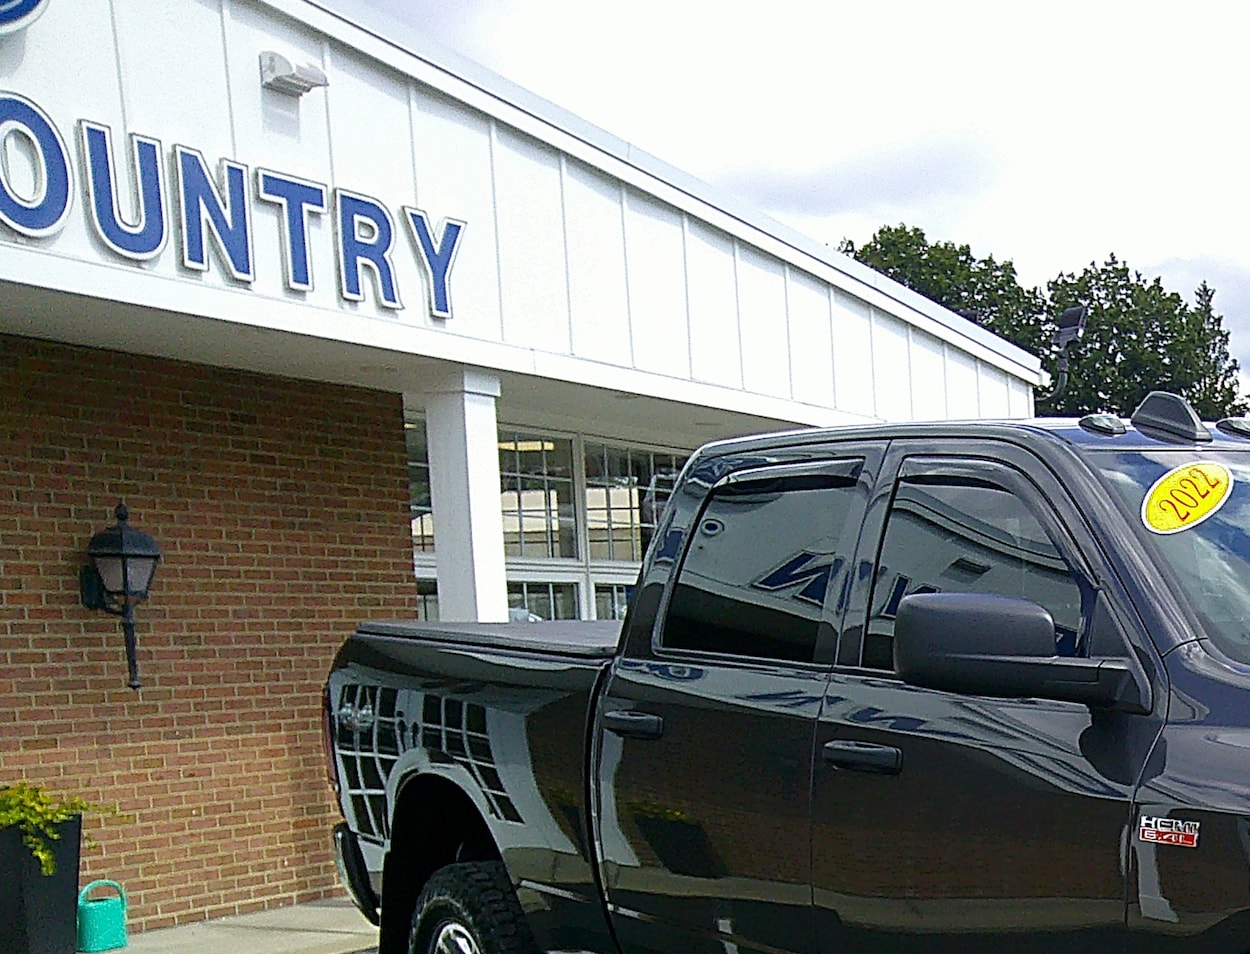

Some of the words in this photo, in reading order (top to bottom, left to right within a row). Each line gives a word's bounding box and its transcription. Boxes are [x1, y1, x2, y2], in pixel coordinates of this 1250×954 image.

[0, 90, 467, 319] OUNTRY
[1159, 467, 1220, 522] 2022
[1141, 816, 1200, 834] HEMI
[1143, 829, 1195, 845] 6.4L
